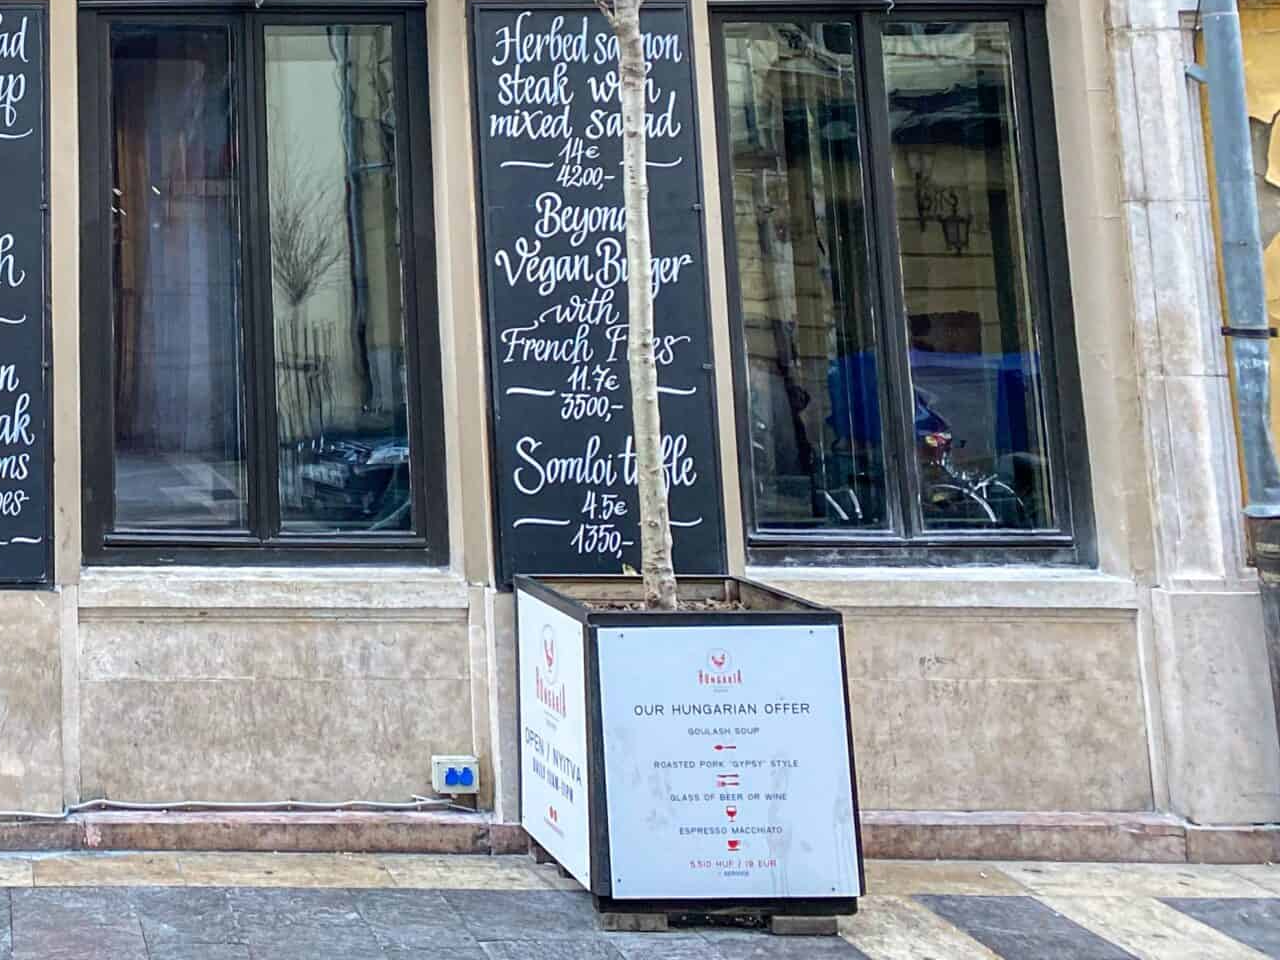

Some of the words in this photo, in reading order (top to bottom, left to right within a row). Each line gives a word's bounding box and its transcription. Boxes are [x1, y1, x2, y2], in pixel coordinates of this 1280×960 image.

[491, 11, 590, 67] Herbed
[593, 32, 684, 66] samon
[497, 63, 575, 107] steak
[587, 61, 662, 104] wih
[489, 104, 574, 140] mixed
[558, 137, 601, 166] 14€
[493, 236, 595, 296] Vegan
[594, 237, 694, 299] Bger
[539, 287, 621, 325] with
[500, 319, 595, 364] French
[604, 323, 691, 366] Fes
[566, 365, 621, 392] 11.7€
[512, 436, 618, 496] Somloi
[617, 434, 697, 492] tfle
[581, 490, 629, 521] 4.5€
[633, 704, 665, 717] OUR
[671, 703, 758, 716] HUNGARIAN
[763, 702, 811, 715] OFFER
[687, 727, 732, 737] GOULASH
[734, 726, 761, 736] SOUP
[653, 760, 696, 770] ROASTED
[699, 760, 725, 769] PORK
[770, 759, 799, 768] STYLE
[669, 793, 701, 803] GLASS
[703, 793, 716, 802] OF
[719, 793, 744, 802] BEER
[747, 793, 761, 802] OR
[765, 792, 788, 801] WINE
[679, 826, 728, 836] ESPRESSO
[731, 826, 784, 835] MACCHIATO
